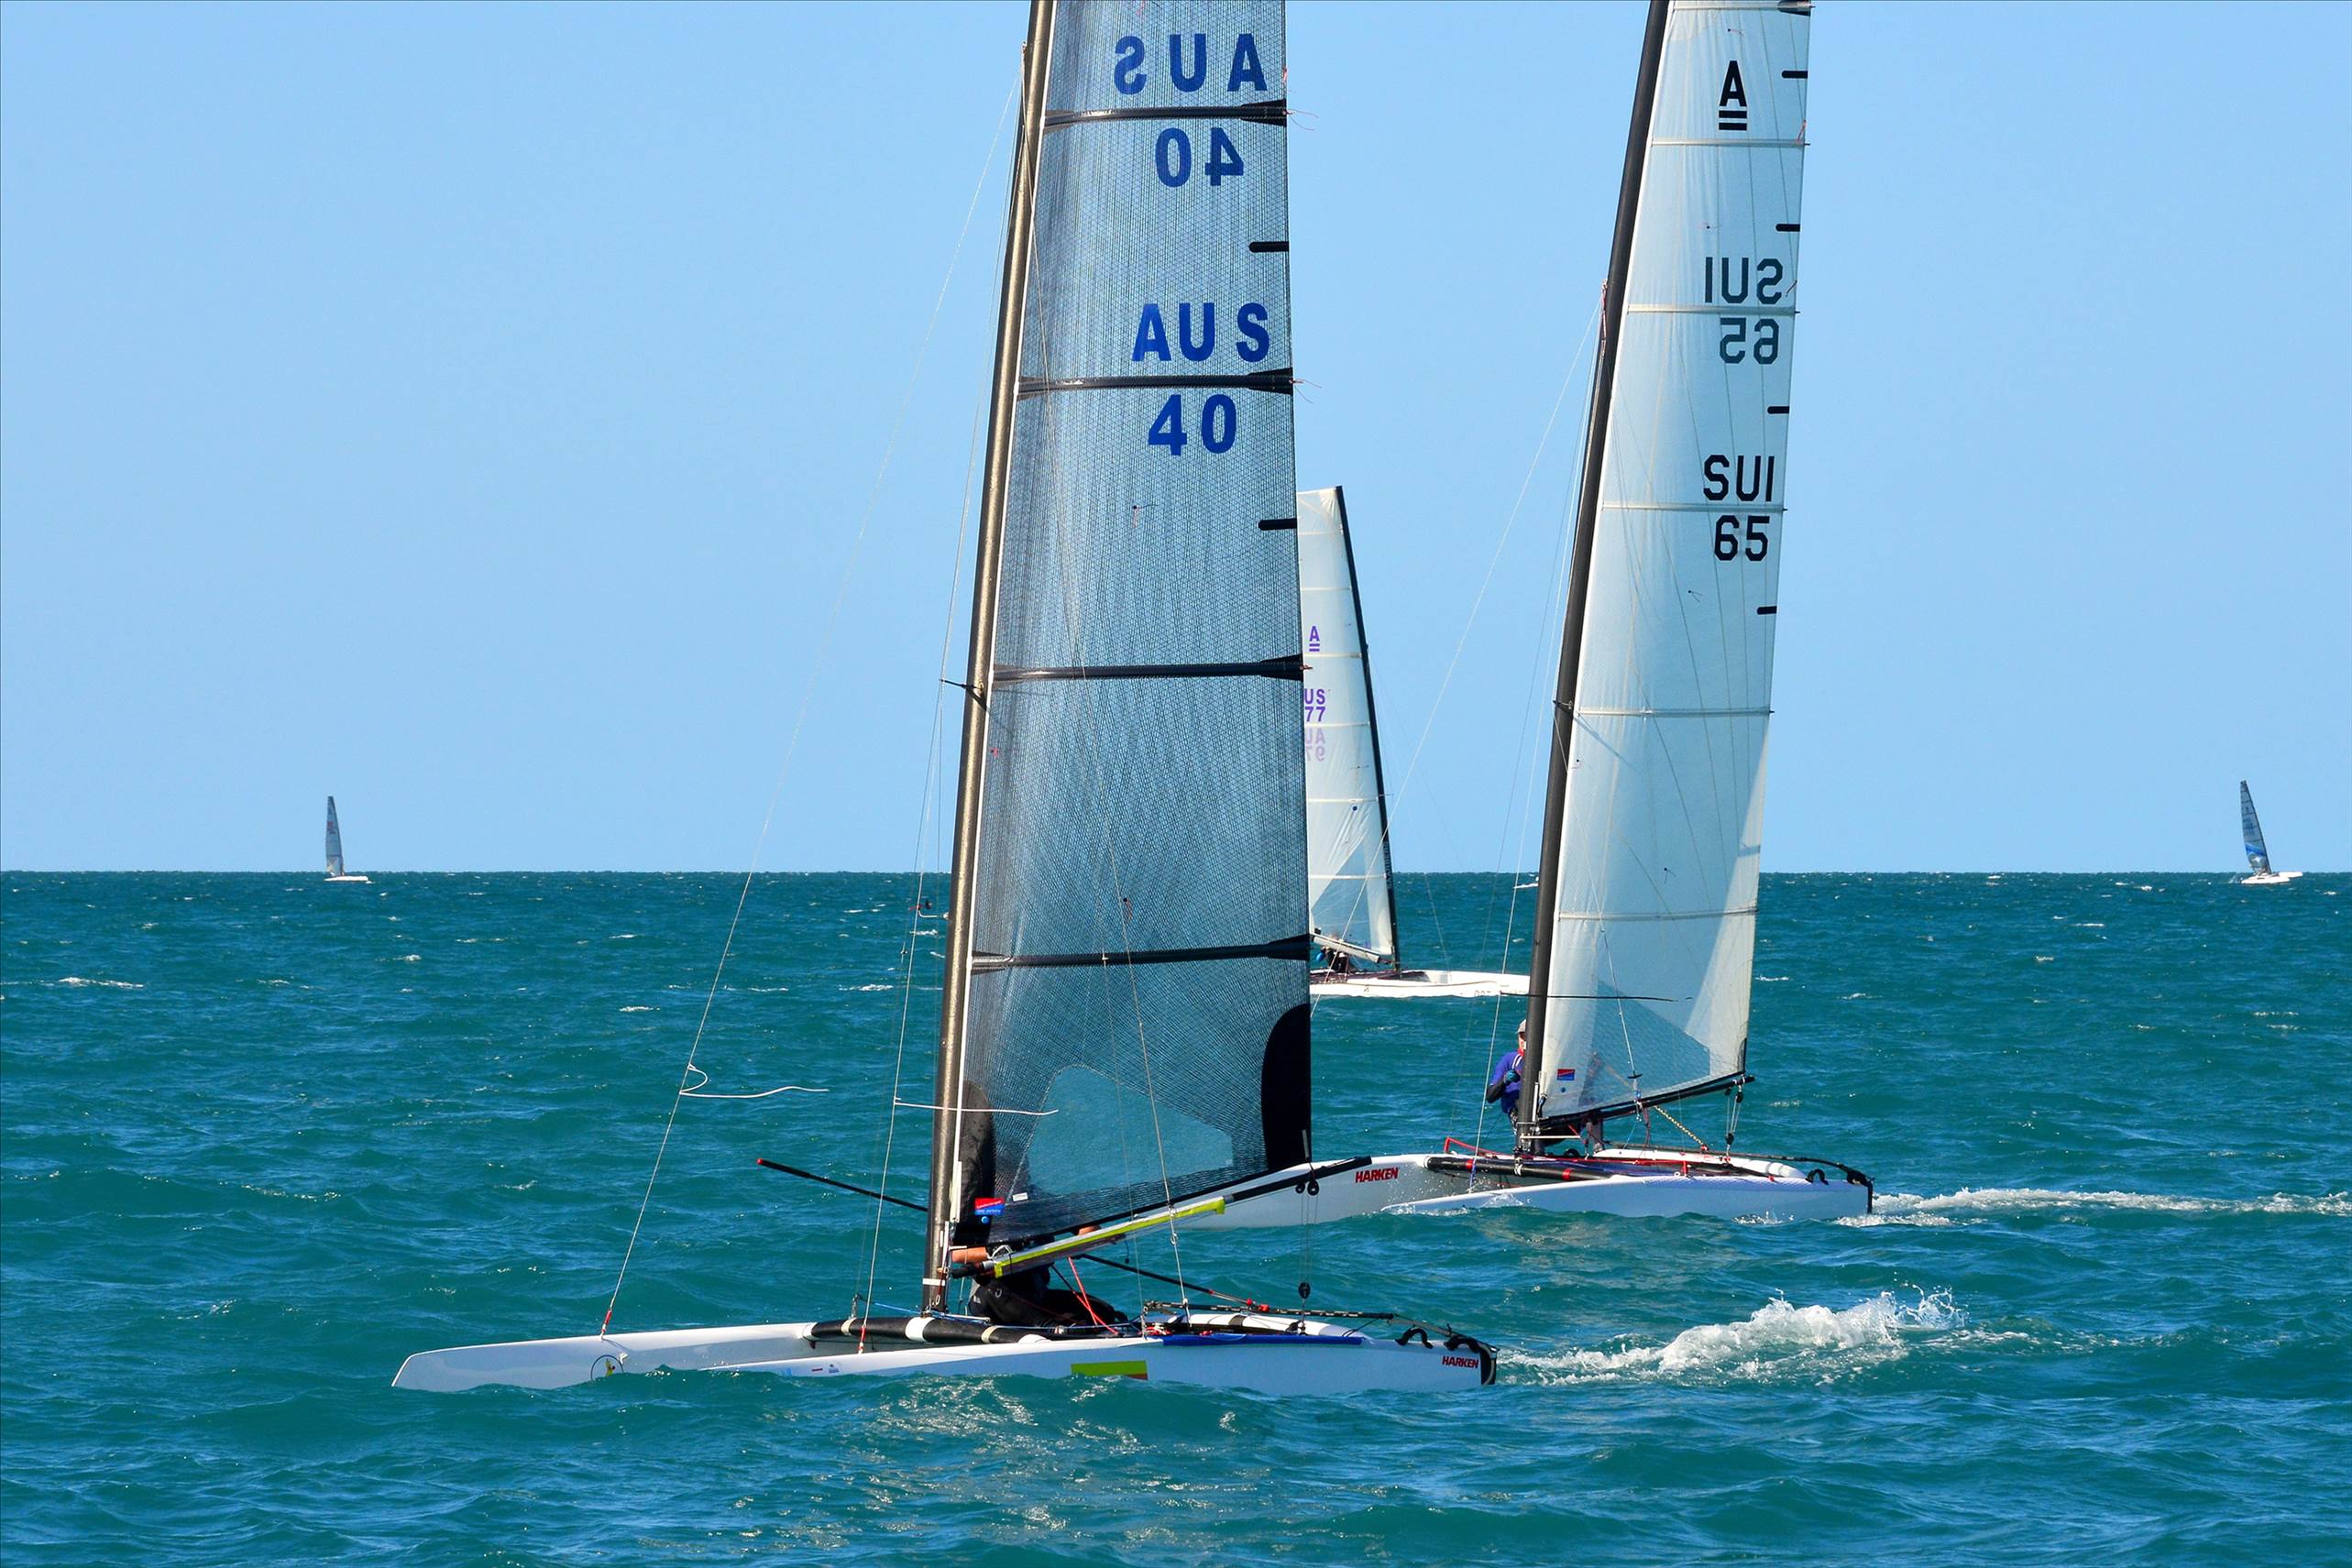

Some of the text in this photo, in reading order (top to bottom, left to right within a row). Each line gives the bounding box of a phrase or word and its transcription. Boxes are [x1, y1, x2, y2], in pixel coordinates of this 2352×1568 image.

[1719, 60, 1747, 106] A
[1132, 302, 1269, 363] AUS
[1149, 394, 1237, 455] 40
[1703, 455, 1775, 502] SUI
[1714, 515, 1770, 562] 65
[1309, 626, 1320, 641] A
[1304, 688, 1325, 705] US
[1304, 707, 1326, 722] 77
[1355, 1167, 1399, 1183] HARKEN
[1442, 1355, 1478, 1368] HARKEN
